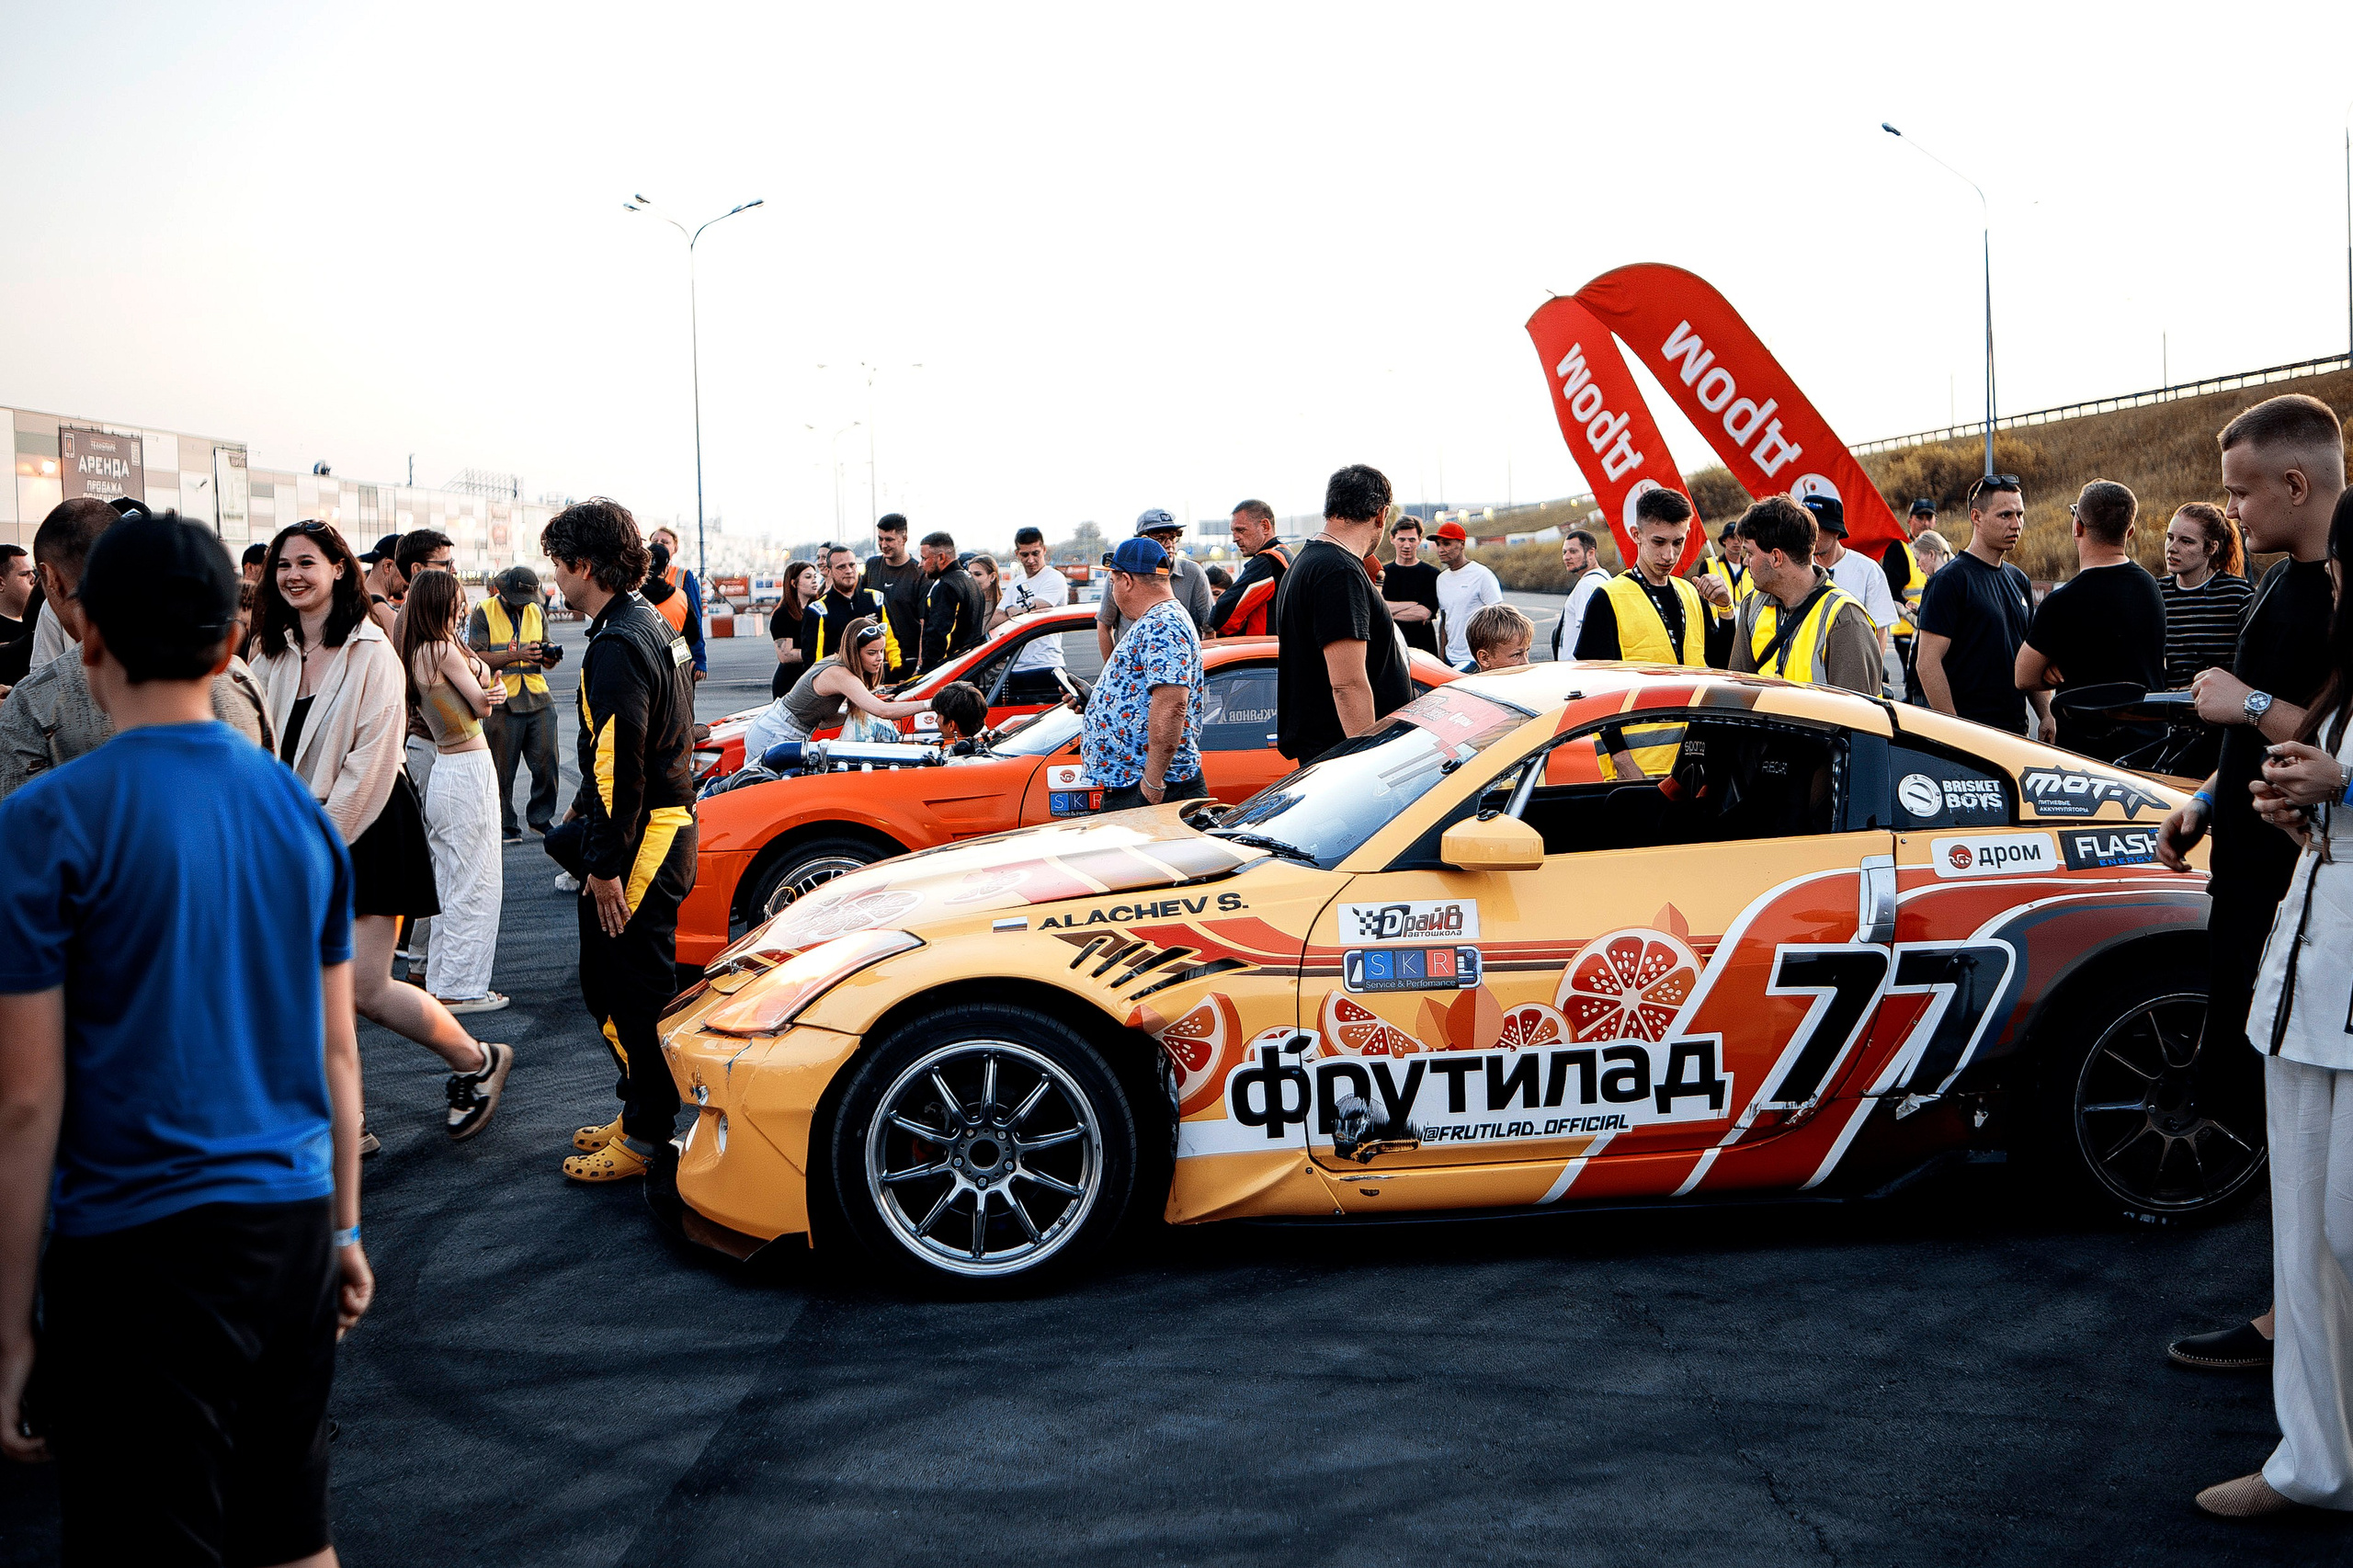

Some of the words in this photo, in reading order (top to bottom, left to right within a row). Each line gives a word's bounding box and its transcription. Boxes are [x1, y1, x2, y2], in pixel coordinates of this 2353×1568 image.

[1661, 319, 1802, 478] дром
[1556, 342, 1643, 483] дром
[78, 454, 130, 479] АРЕНДА
[1942, 779, 2000, 793] BRISKET
[1054, 793, 1102, 809] SKR
[1945, 792, 2003, 810] BOYS
[1978, 843, 2041, 869] дром
[2075, 834, 2158, 859] FLASH
[2098, 855, 2154, 867] ENERGY
[1037, 896, 1209, 931] ALACHEV
[1217, 892, 1249, 912] S.
[1370, 952, 1449, 976] SKR
[1366, 980, 1396, 989] Service
[1397, 980, 1404, 988] &
[1766, 938, 2017, 1110] 77
[1423, 1114, 1630, 1143] @FRUTILAD_OFFICIAL
